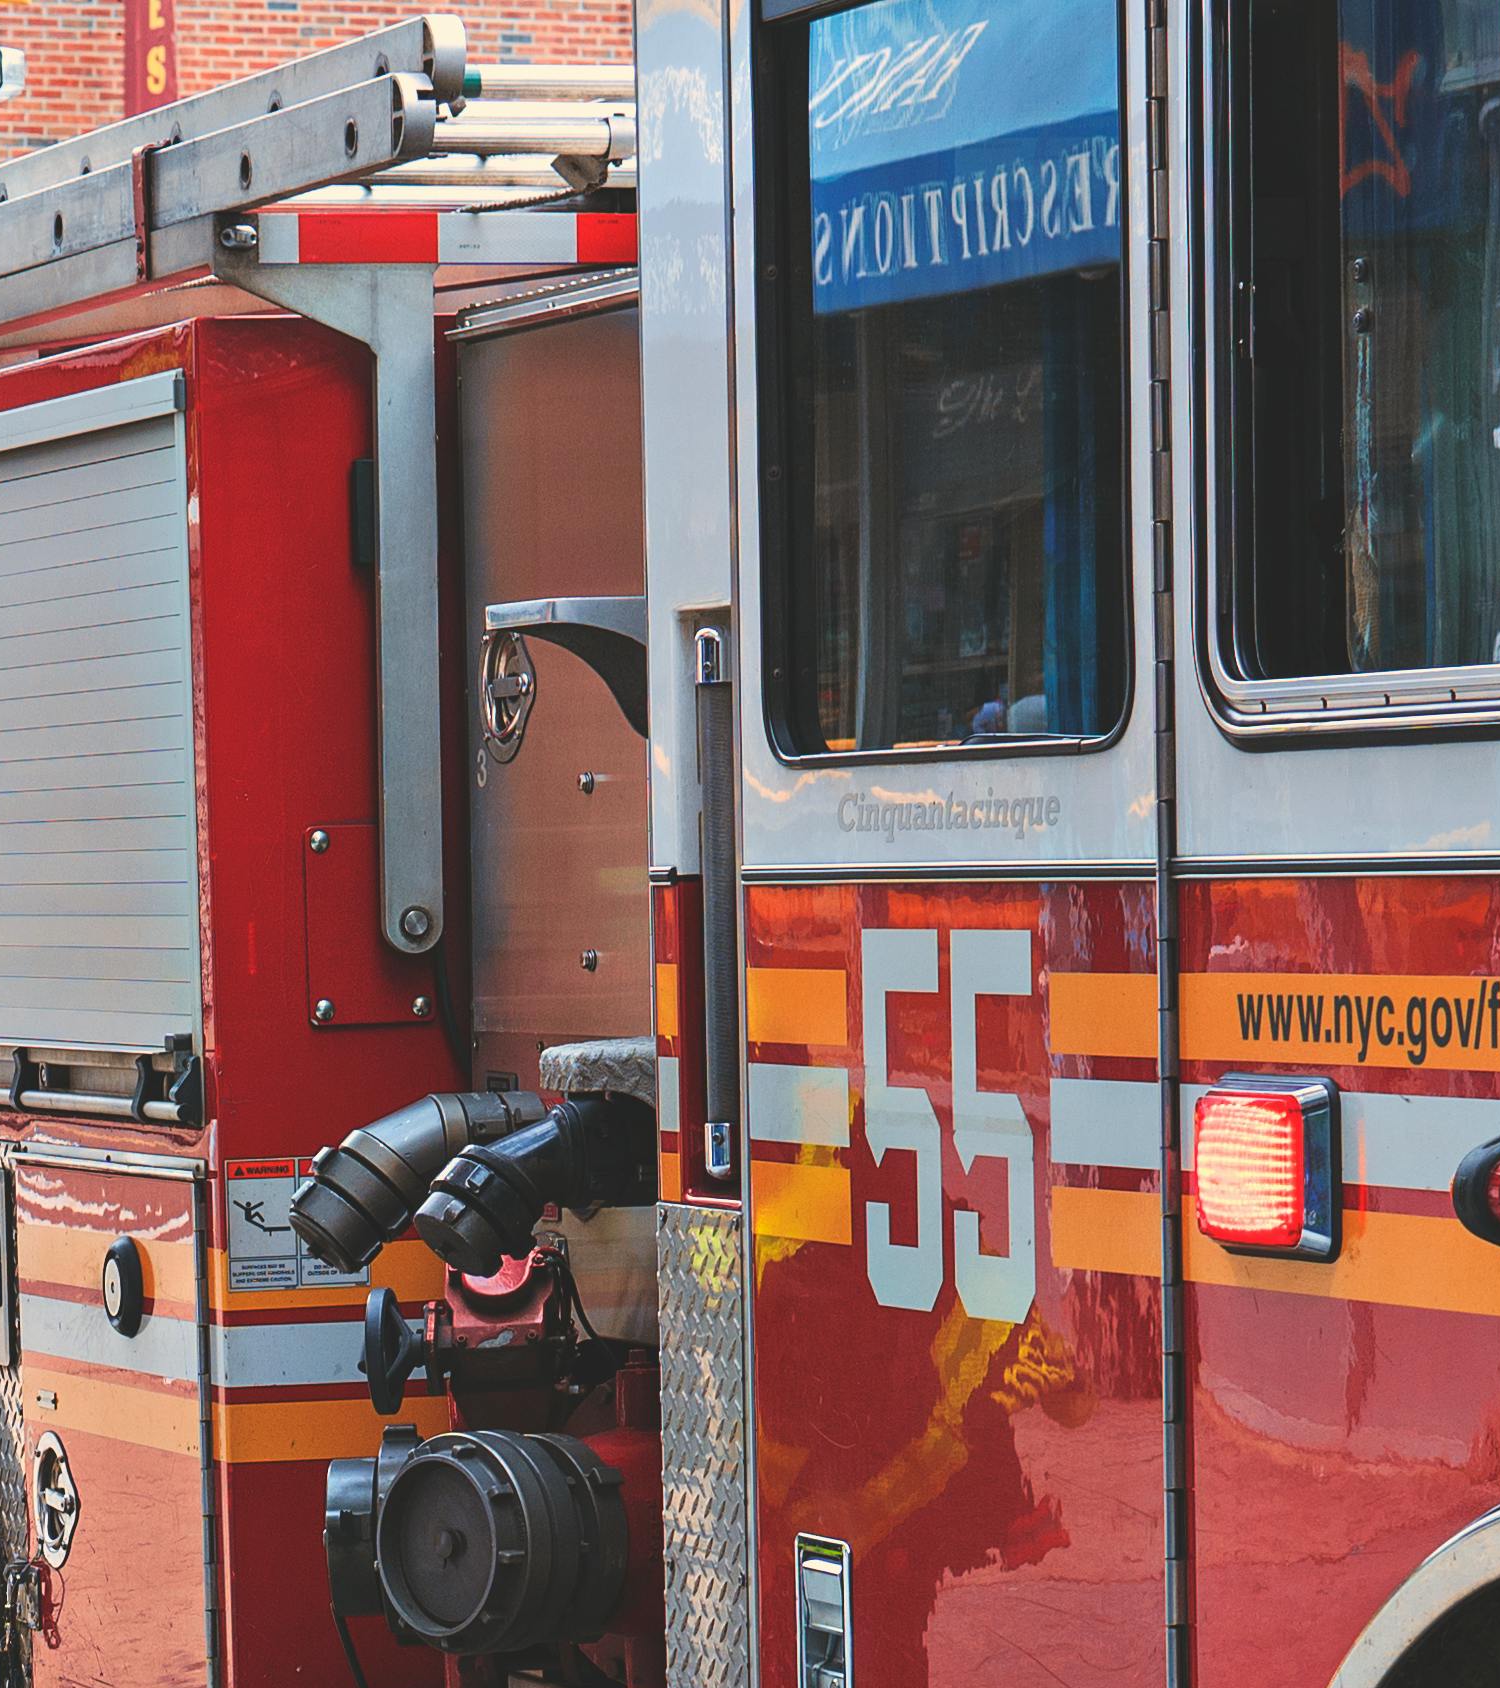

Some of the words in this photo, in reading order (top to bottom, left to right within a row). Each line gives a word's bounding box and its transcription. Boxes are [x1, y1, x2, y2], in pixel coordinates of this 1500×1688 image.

[837, 787, 1061, 844] Cinquantacinque
[861, 928, 1036, 1325] 55
[246, 1165, 289, 1175] WARNING
